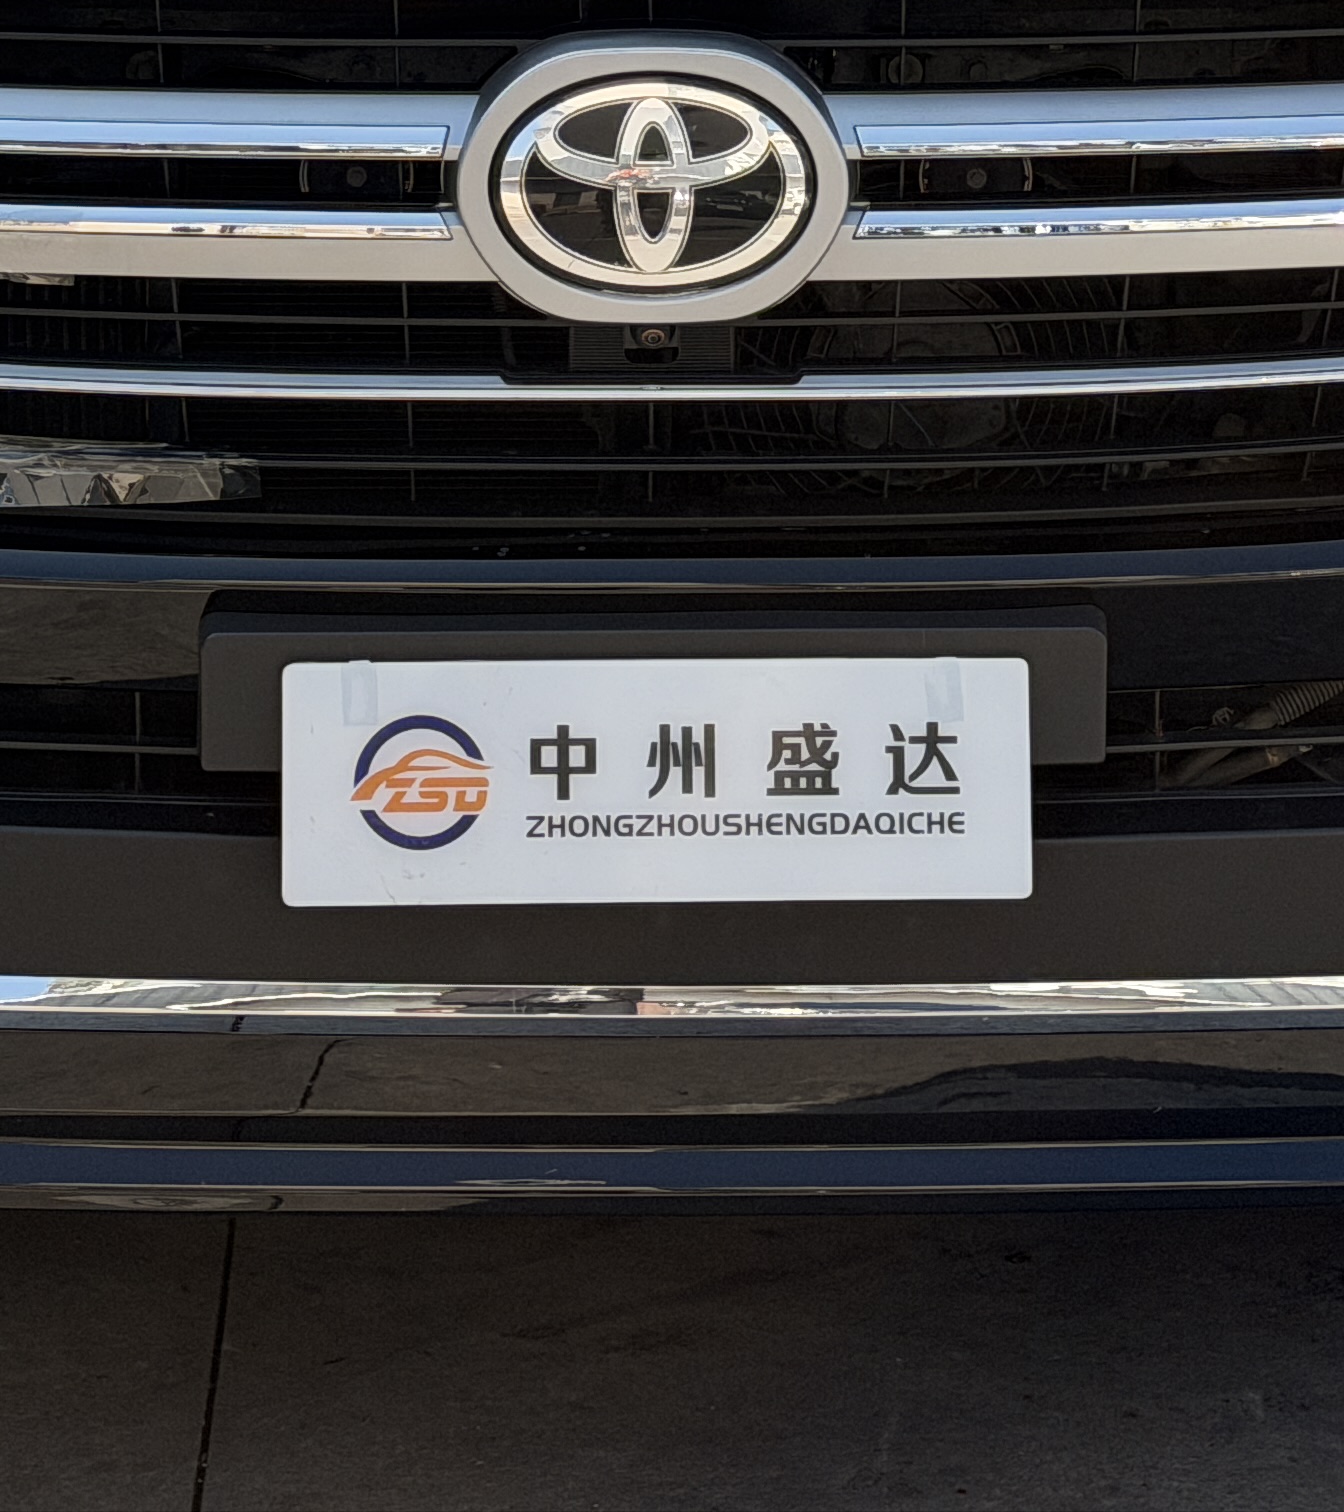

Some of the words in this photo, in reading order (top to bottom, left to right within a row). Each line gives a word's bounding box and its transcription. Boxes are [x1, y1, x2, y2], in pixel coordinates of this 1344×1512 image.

[529, 721, 961, 801] 中州盛达
[525, 811, 966, 839] ZHONGZHOUSHENGDAQICHE
